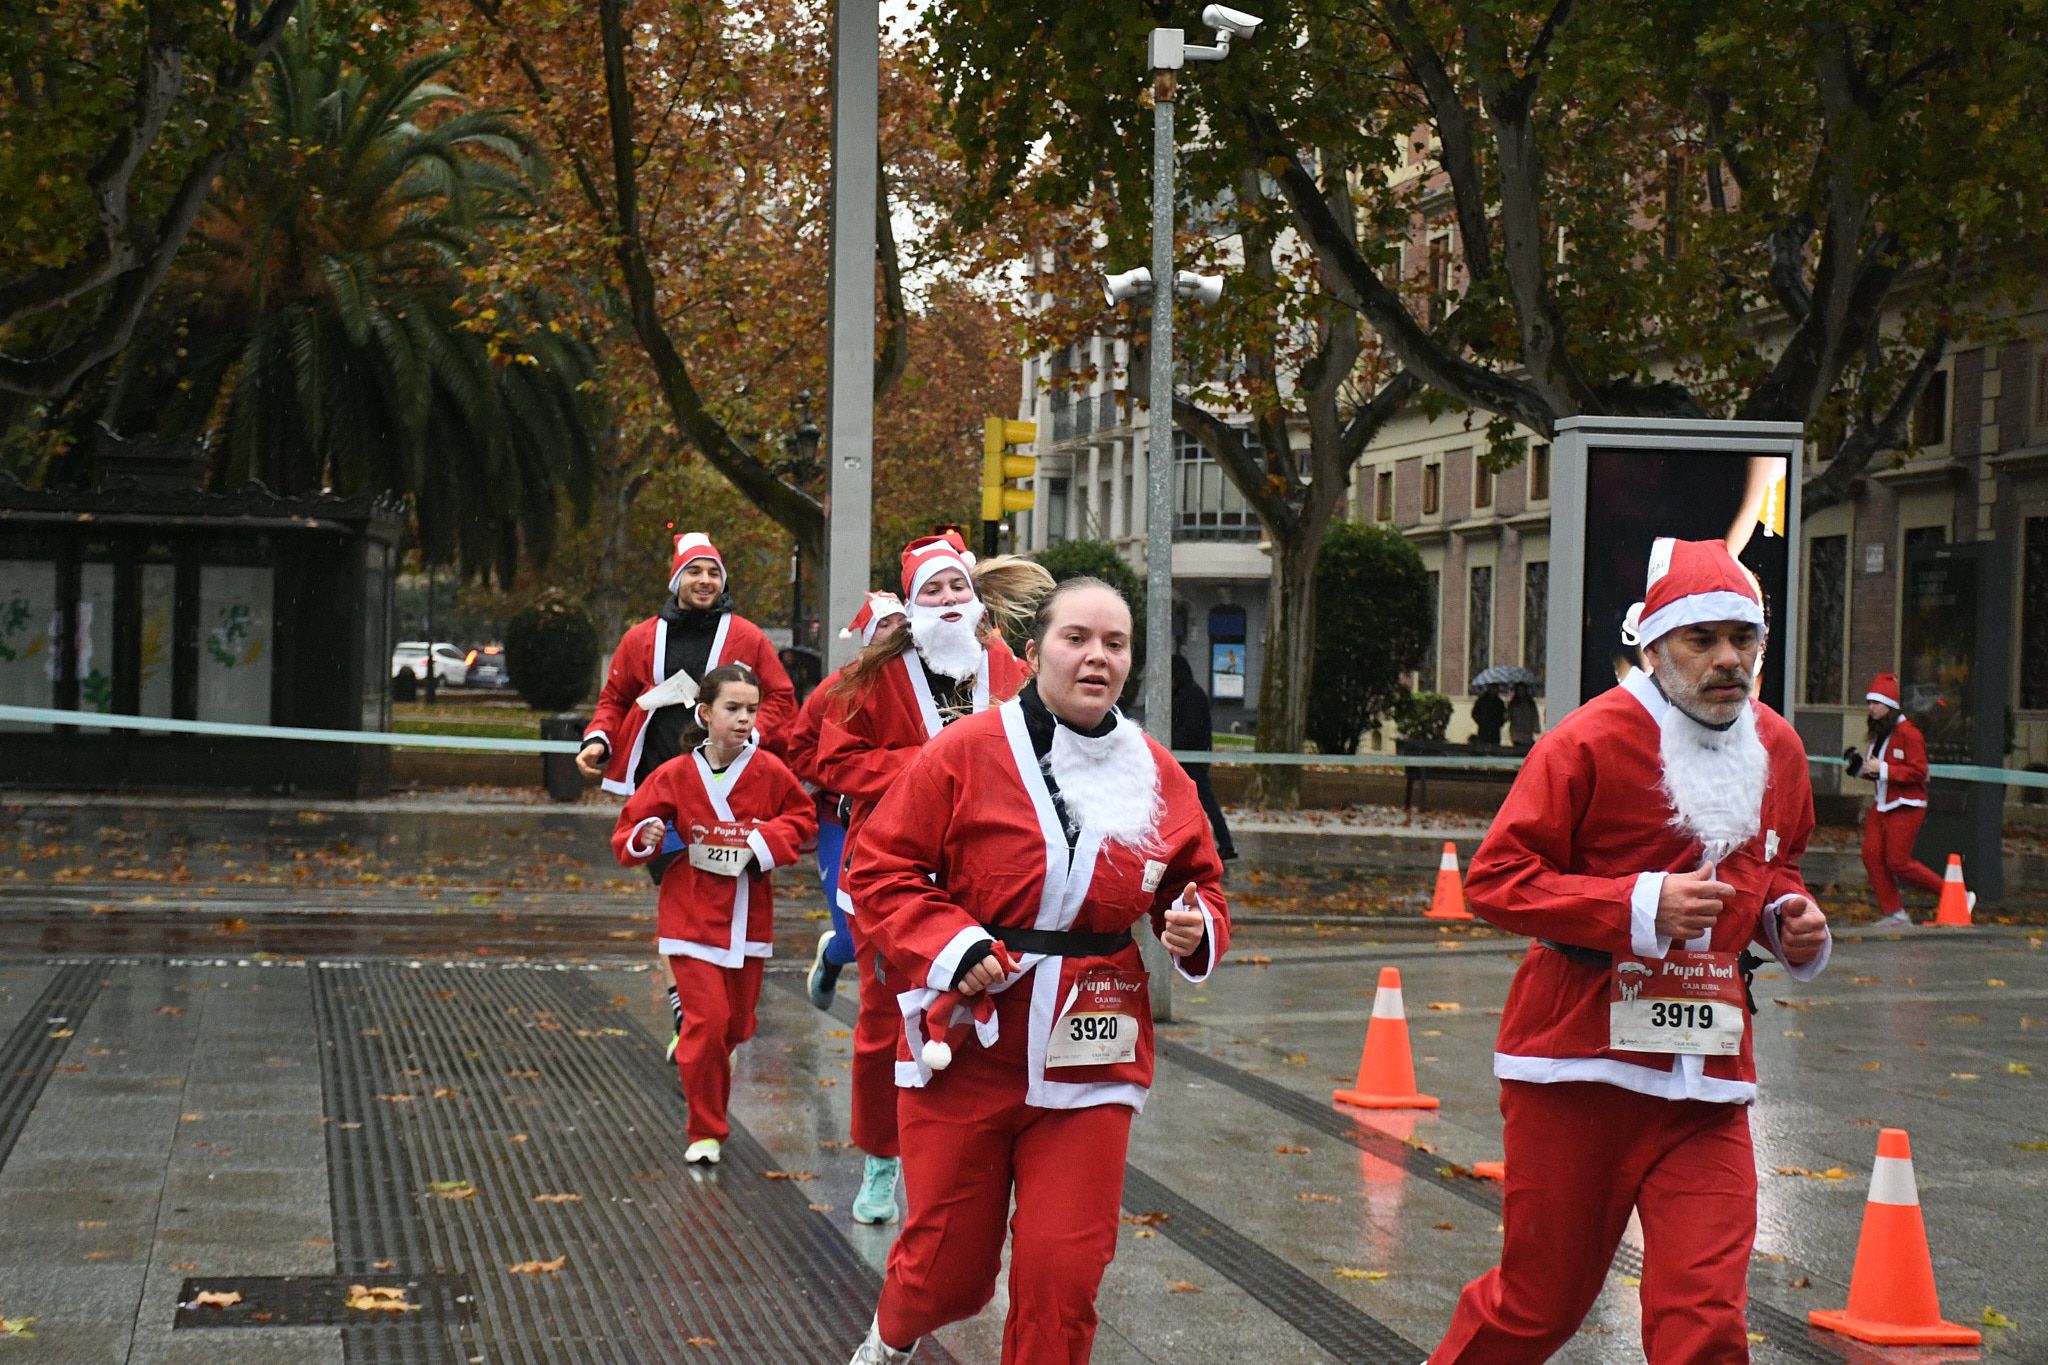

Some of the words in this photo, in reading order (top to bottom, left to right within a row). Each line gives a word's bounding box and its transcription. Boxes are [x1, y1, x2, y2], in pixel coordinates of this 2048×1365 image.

[713, 827, 736, 837] Papá
[708, 848, 738, 862] 2211
[1662, 962, 1703, 979] Papá
[1708, 963, 1733, 978] Noel
[1079, 977, 1111, 994] Papá
[1113, 978, 1141, 992] Noel
[1682, 982, 1699, 990] CAJA
[1651, 1003, 1713, 1029] 3919
[1070, 1016, 1118, 1041] 3920
